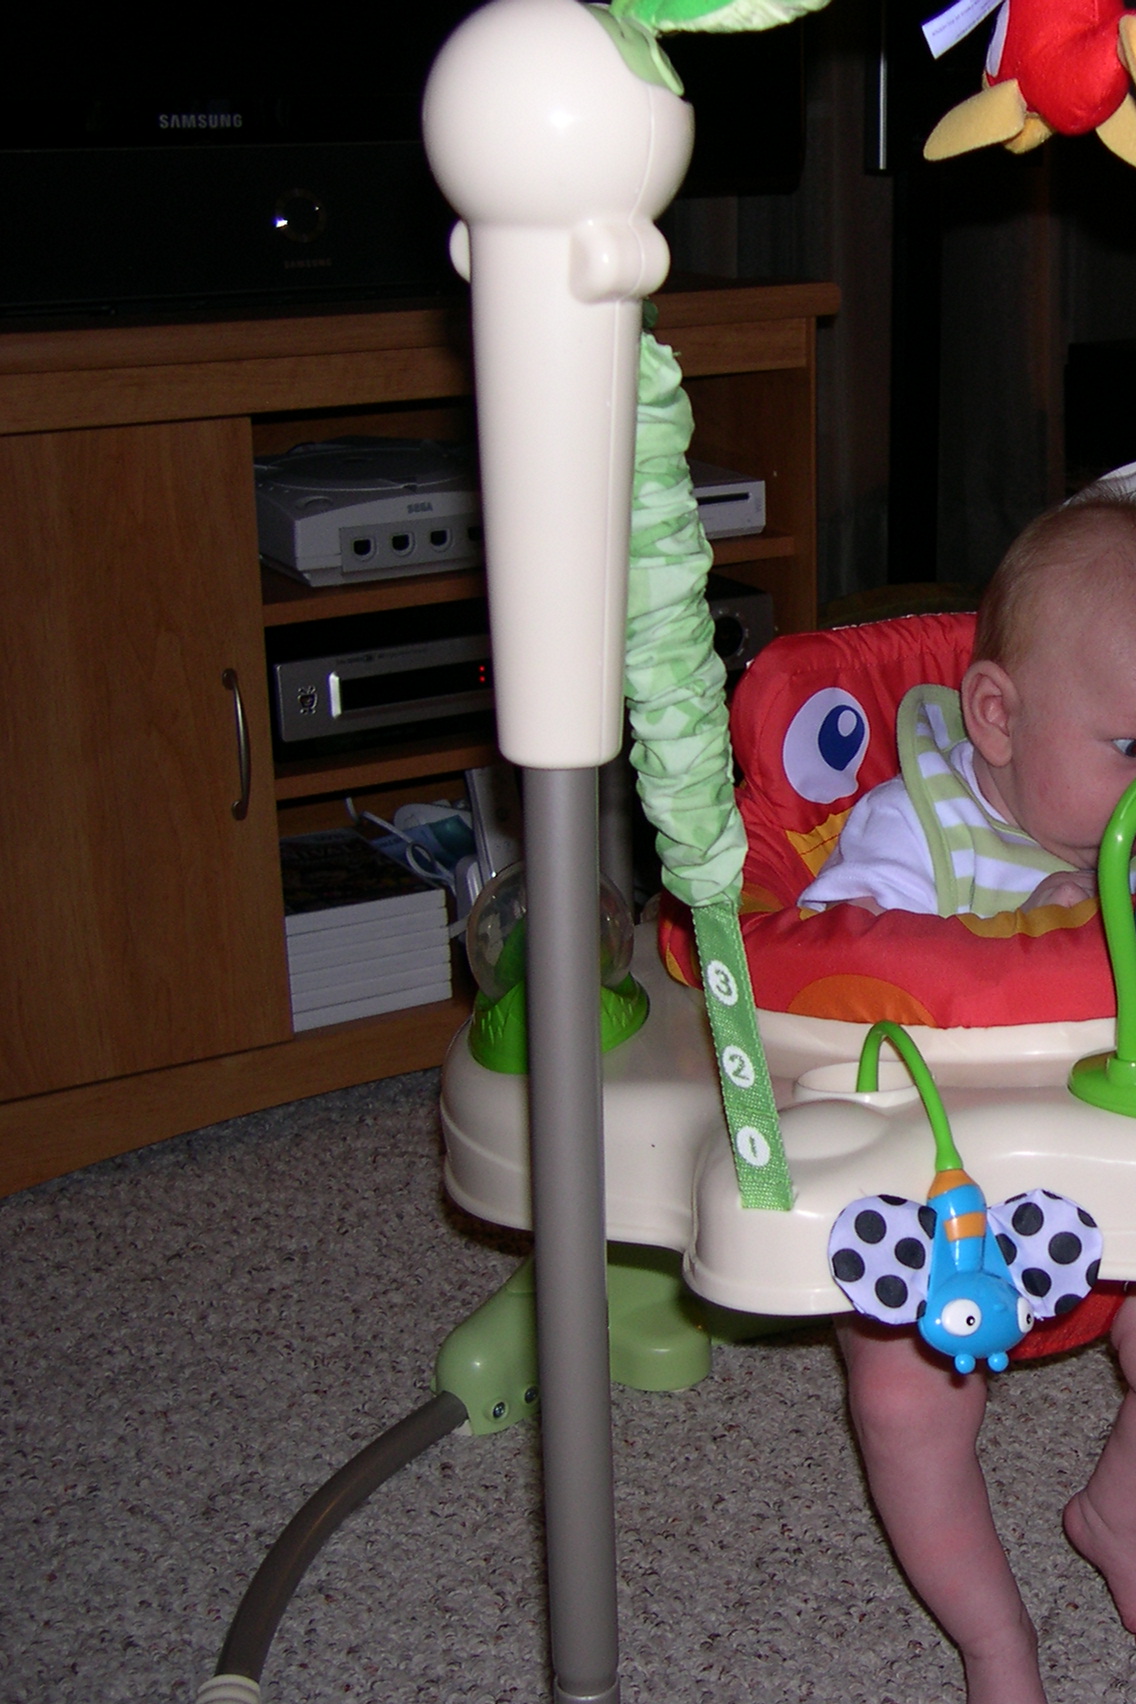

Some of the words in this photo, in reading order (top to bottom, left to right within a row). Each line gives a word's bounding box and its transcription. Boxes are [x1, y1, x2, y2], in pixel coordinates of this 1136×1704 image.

[158, 113, 243, 129] SAMSUNG
[407, 502, 433, 514] SEGA
[714, 968, 733, 997] 3
[729, 1053, 750, 1081] 2
